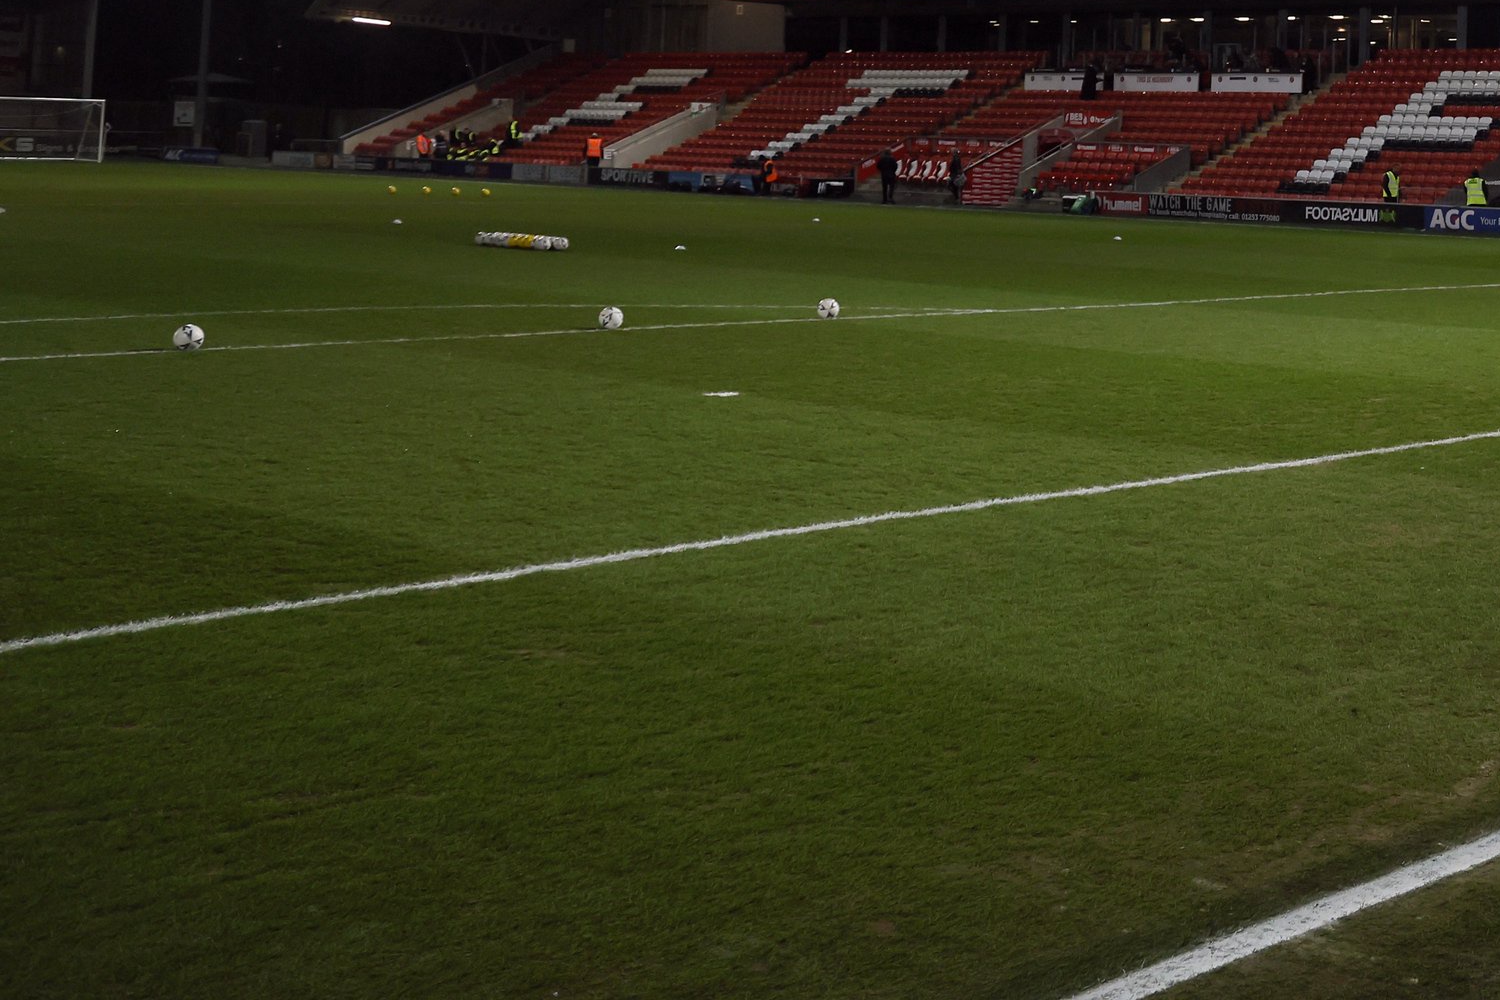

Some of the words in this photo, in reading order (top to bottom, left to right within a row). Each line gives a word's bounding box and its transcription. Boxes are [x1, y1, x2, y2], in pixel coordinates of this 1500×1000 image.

[600, 169, 654, 184] SPORTFIVE
[1102, 196, 1142, 211] hummel
[1149, 195, 1181, 209] WATCH
[1185, 196, 1202, 210] THE
[1206, 197, 1232, 212] GAME
[1305, 206, 1378, 223] FOOTASYLUM
[1430, 208, 1475, 231] AGC
[1480, 216, 1497, 226] Your
